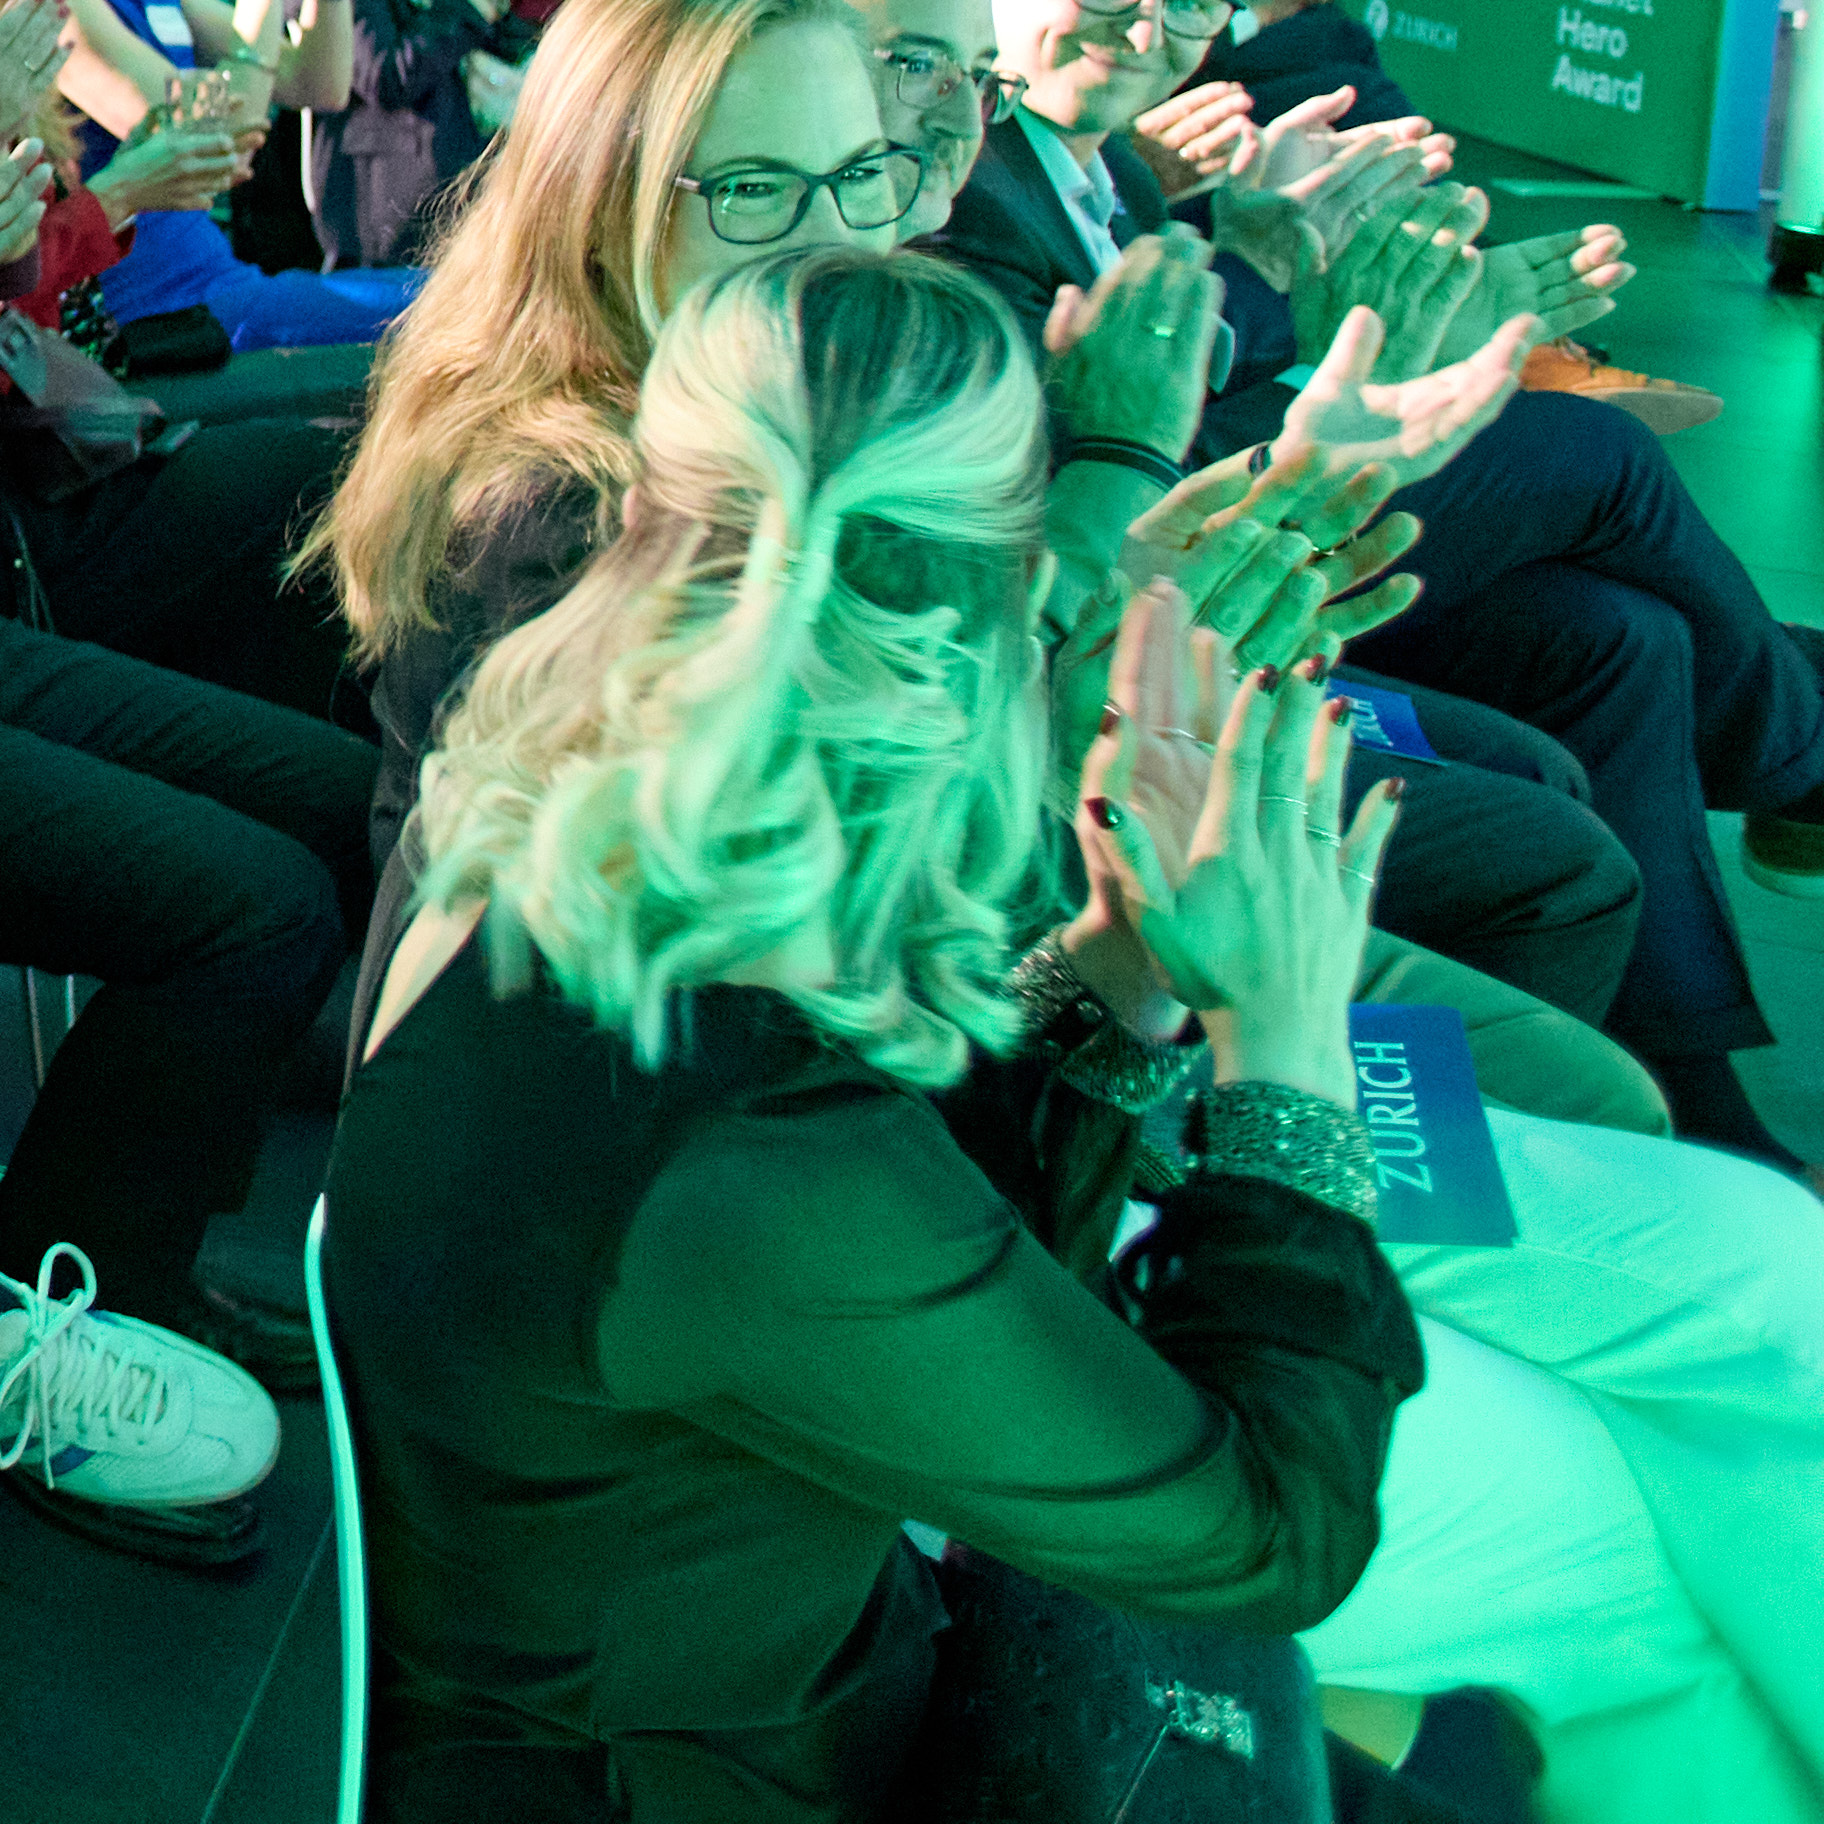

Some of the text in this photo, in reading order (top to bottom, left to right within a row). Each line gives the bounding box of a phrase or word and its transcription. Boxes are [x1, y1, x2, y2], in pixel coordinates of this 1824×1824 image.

[1556, 4, 1628, 59] Hero
[1552, 53, 1643, 114] Award
[1354, 1041, 1433, 1193] ZURICH
